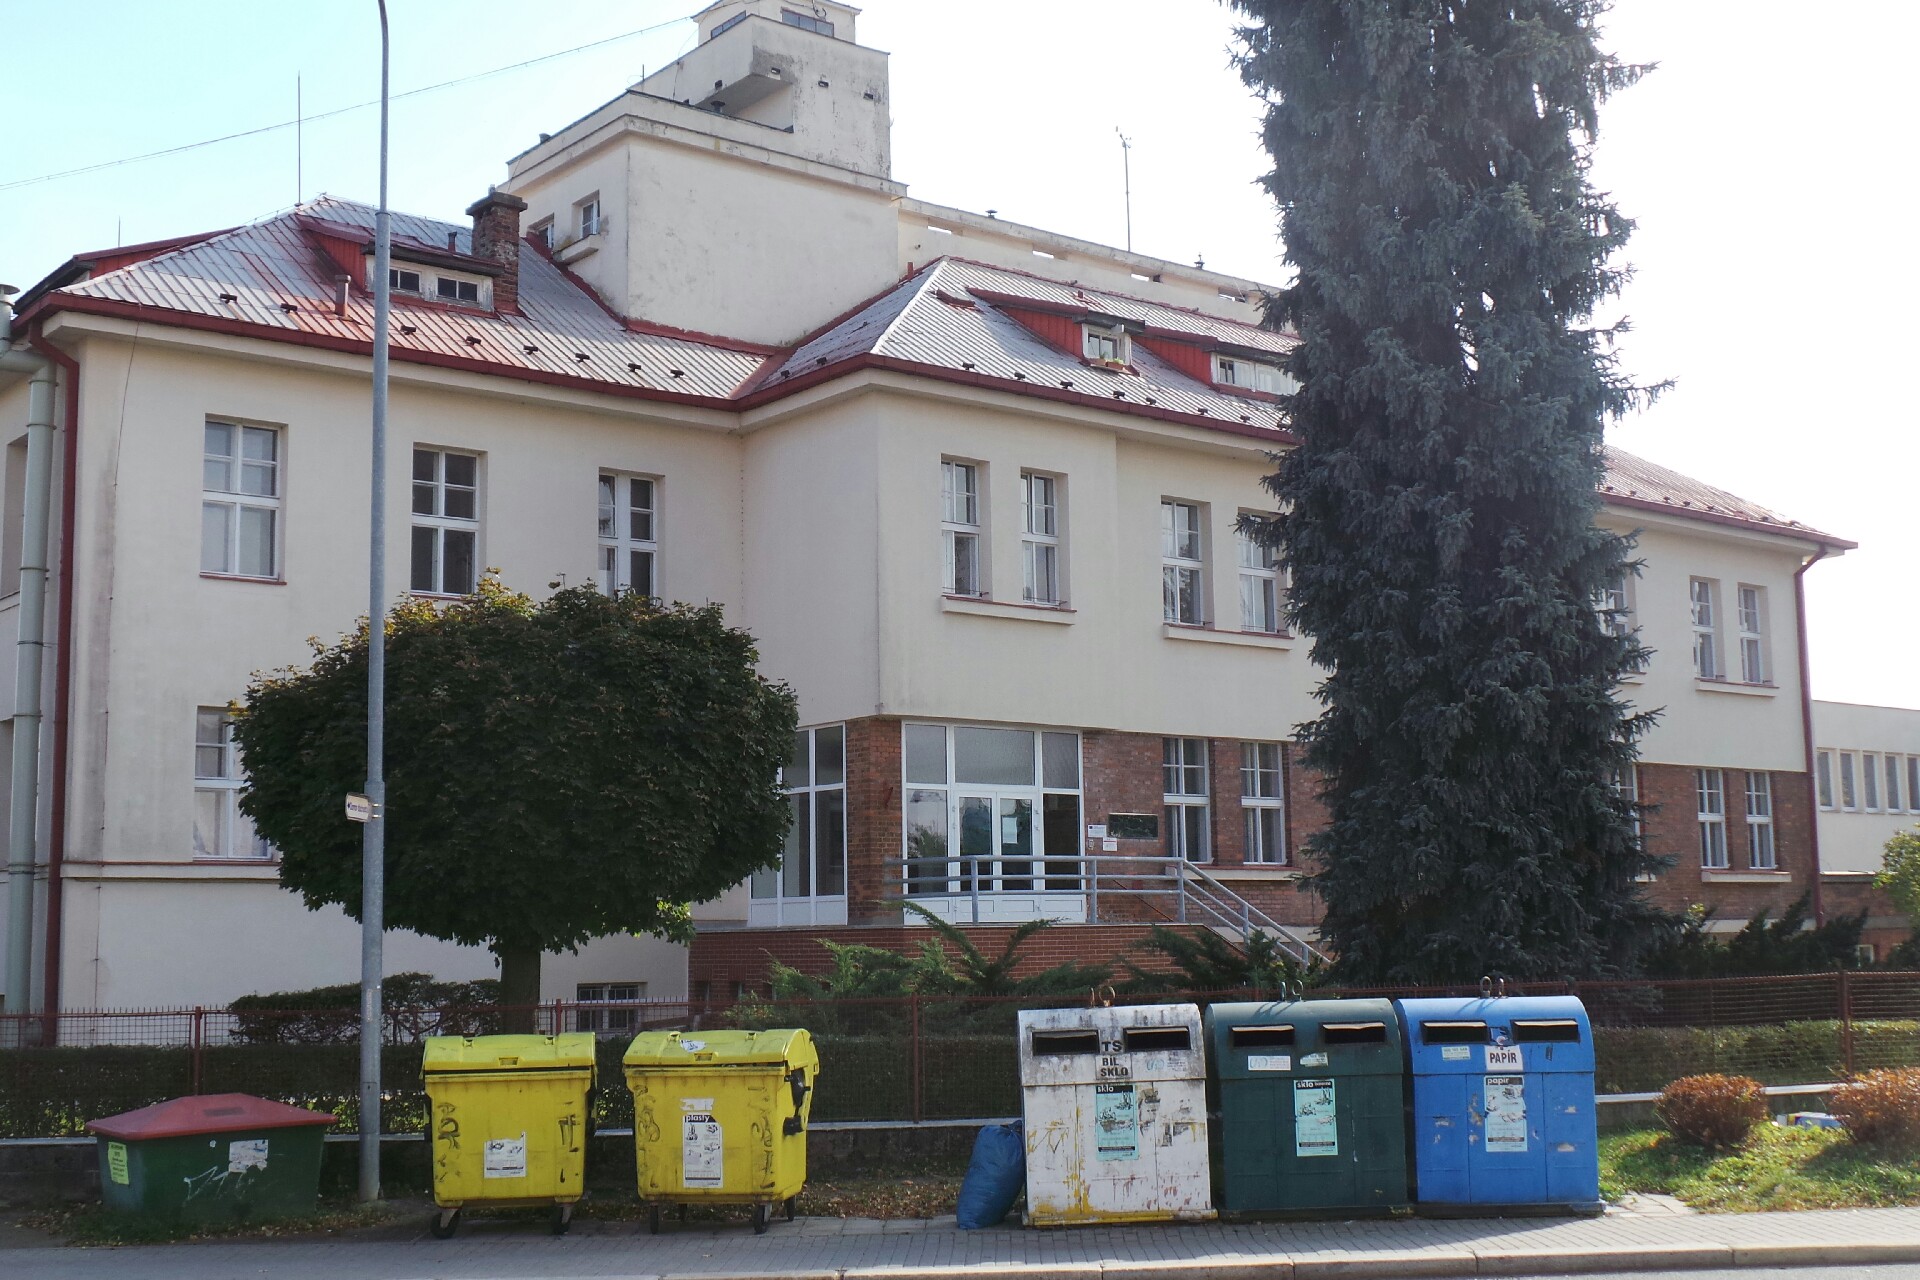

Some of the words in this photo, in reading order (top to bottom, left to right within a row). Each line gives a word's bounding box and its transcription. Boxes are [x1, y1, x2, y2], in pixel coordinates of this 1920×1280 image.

[1101, 1040, 1123, 1052] TS
[1489, 1049, 1517, 1063] PAPÍR
[1100, 1067, 1129, 1077] SKLO
